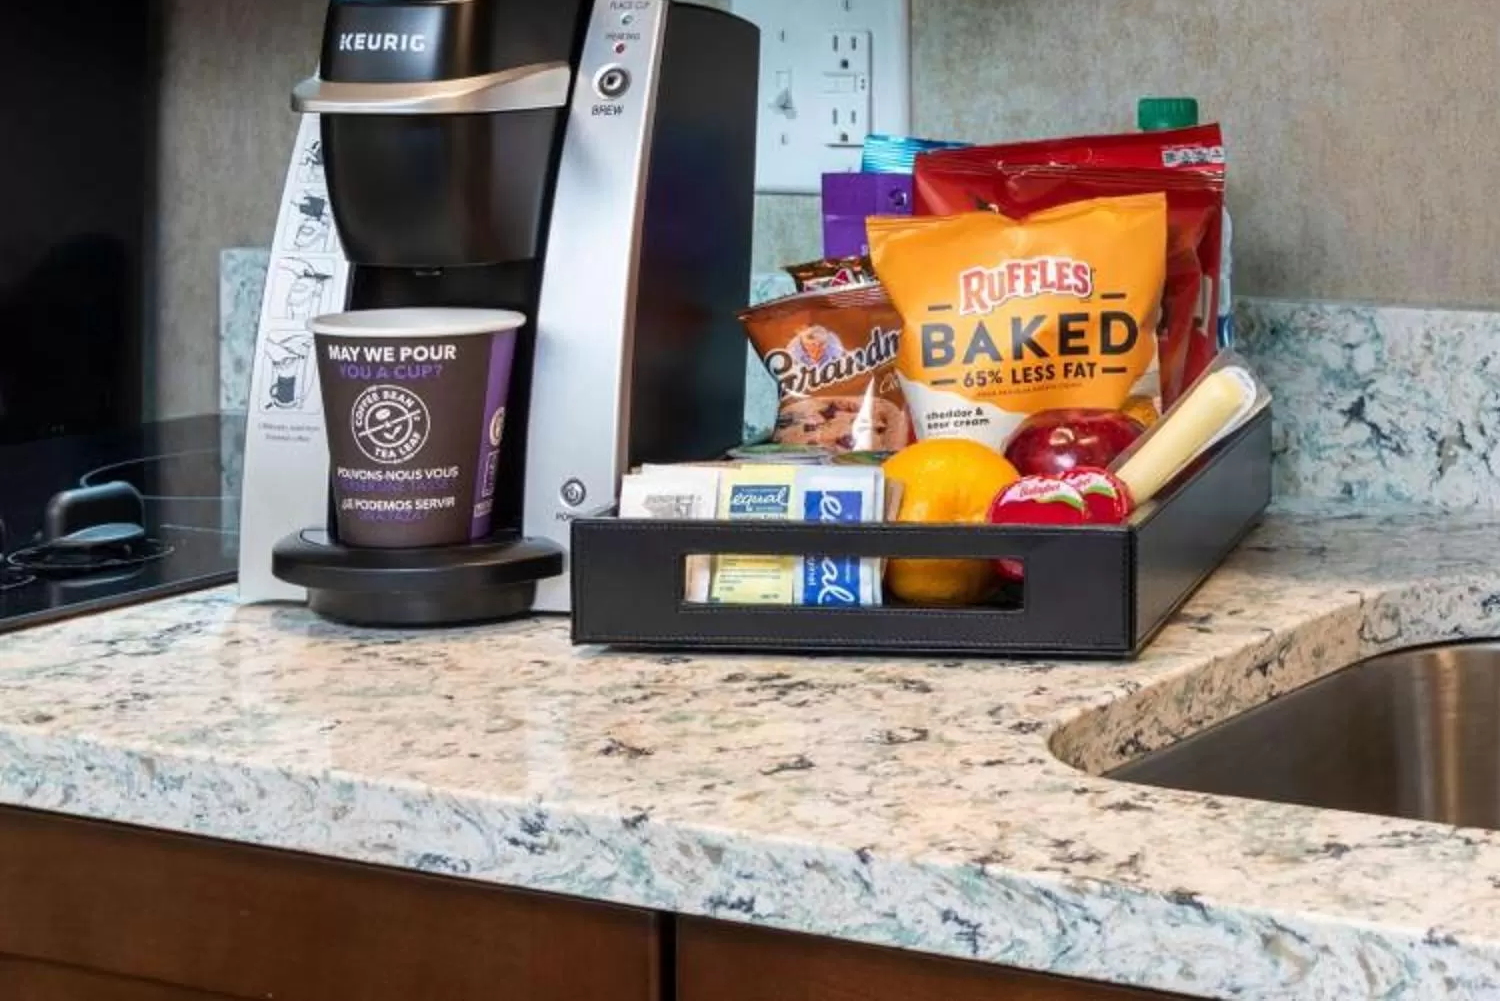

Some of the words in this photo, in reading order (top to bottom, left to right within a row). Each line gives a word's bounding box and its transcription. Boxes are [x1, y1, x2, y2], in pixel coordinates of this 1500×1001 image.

[339, 32, 426, 52] KEURIG
[591, 104, 624, 116] BREW
[960, 257, 1092, 314] RUFFLES
[921, 310, 1139, 369] BAKED
[328, 345, 361, 362] MAY
[363, 346, 396, 362] WE
[400, 344, 457, 361] POUR
[340, 363, 372, 378] YOU
[375, 365, 389, 378] A
[393, 363, 442, 379] CUP?
[963, 368, 1004, 389] 65%
[1011, 365, 1056, 385] LESS
[1063, 361, 1098, 379] FAT
[925, 408, 973, 421] cheddar
[954, 417, 990, 428] cream
[732, 486, 788, 512] equal
